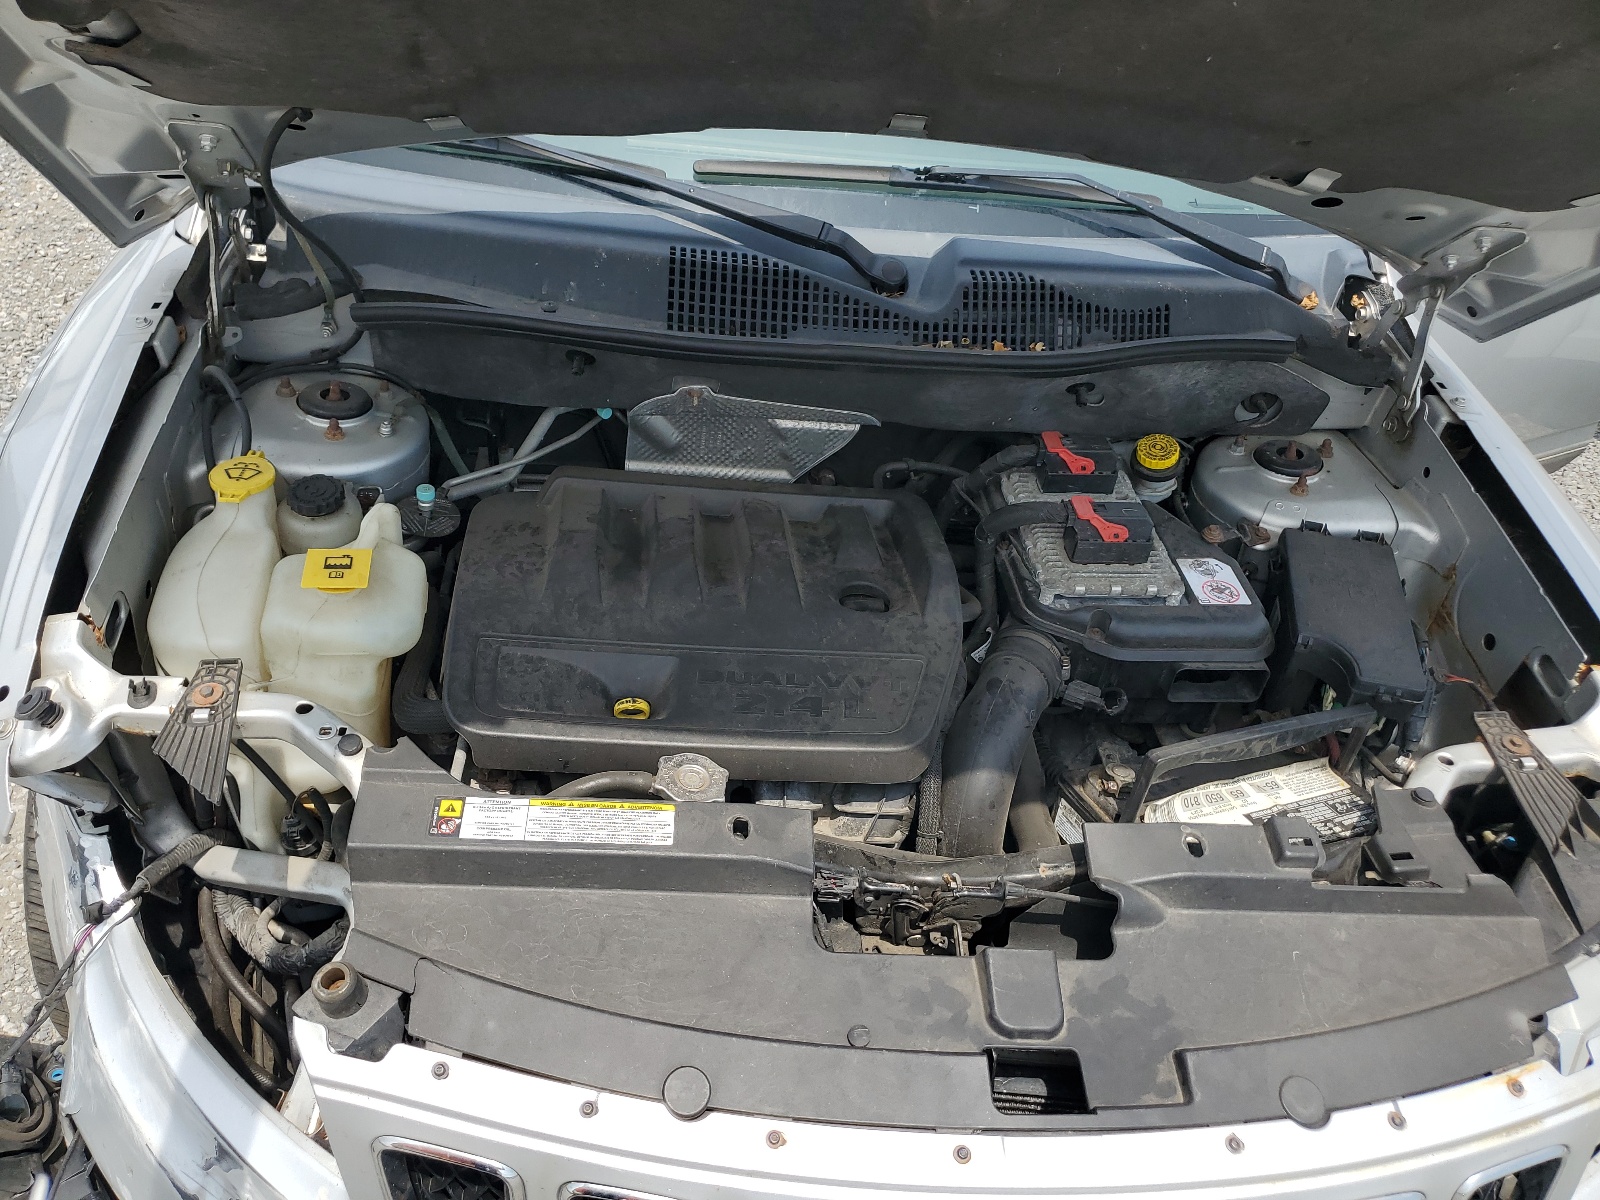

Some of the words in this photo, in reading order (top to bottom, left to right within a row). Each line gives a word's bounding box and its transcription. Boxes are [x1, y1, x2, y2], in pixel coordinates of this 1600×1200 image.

[697, 670, 809, 688] DUAL
[733, 693, 877, 720] 2.4L
[1230, 789, 1245, 799] 65
[1183, 796, 1201, 808] 810
